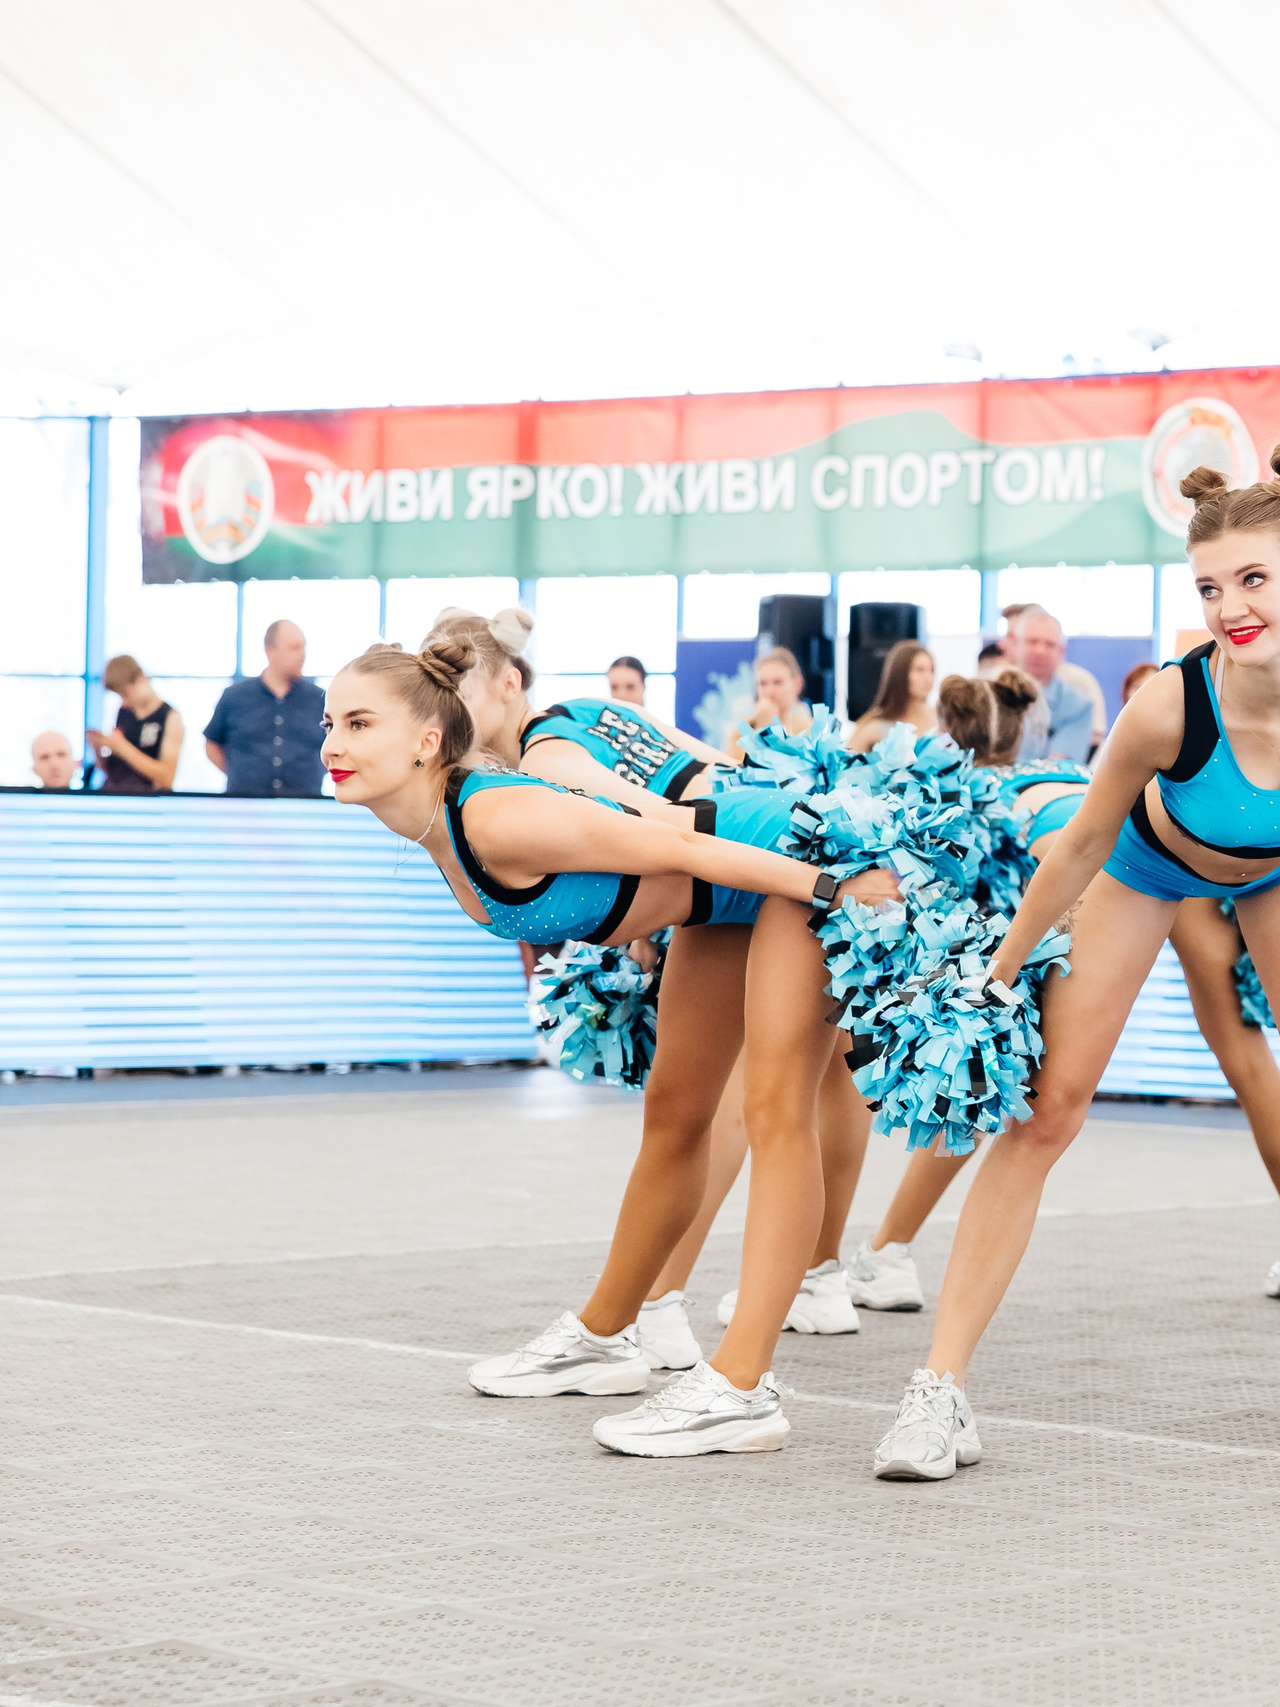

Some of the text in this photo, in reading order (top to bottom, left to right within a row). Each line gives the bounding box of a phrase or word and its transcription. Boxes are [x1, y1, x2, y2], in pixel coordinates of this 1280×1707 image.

[304, 447, 1106, 524] ЖИВИ ЯРКО! ЖИВИ СПОРТОМ!
